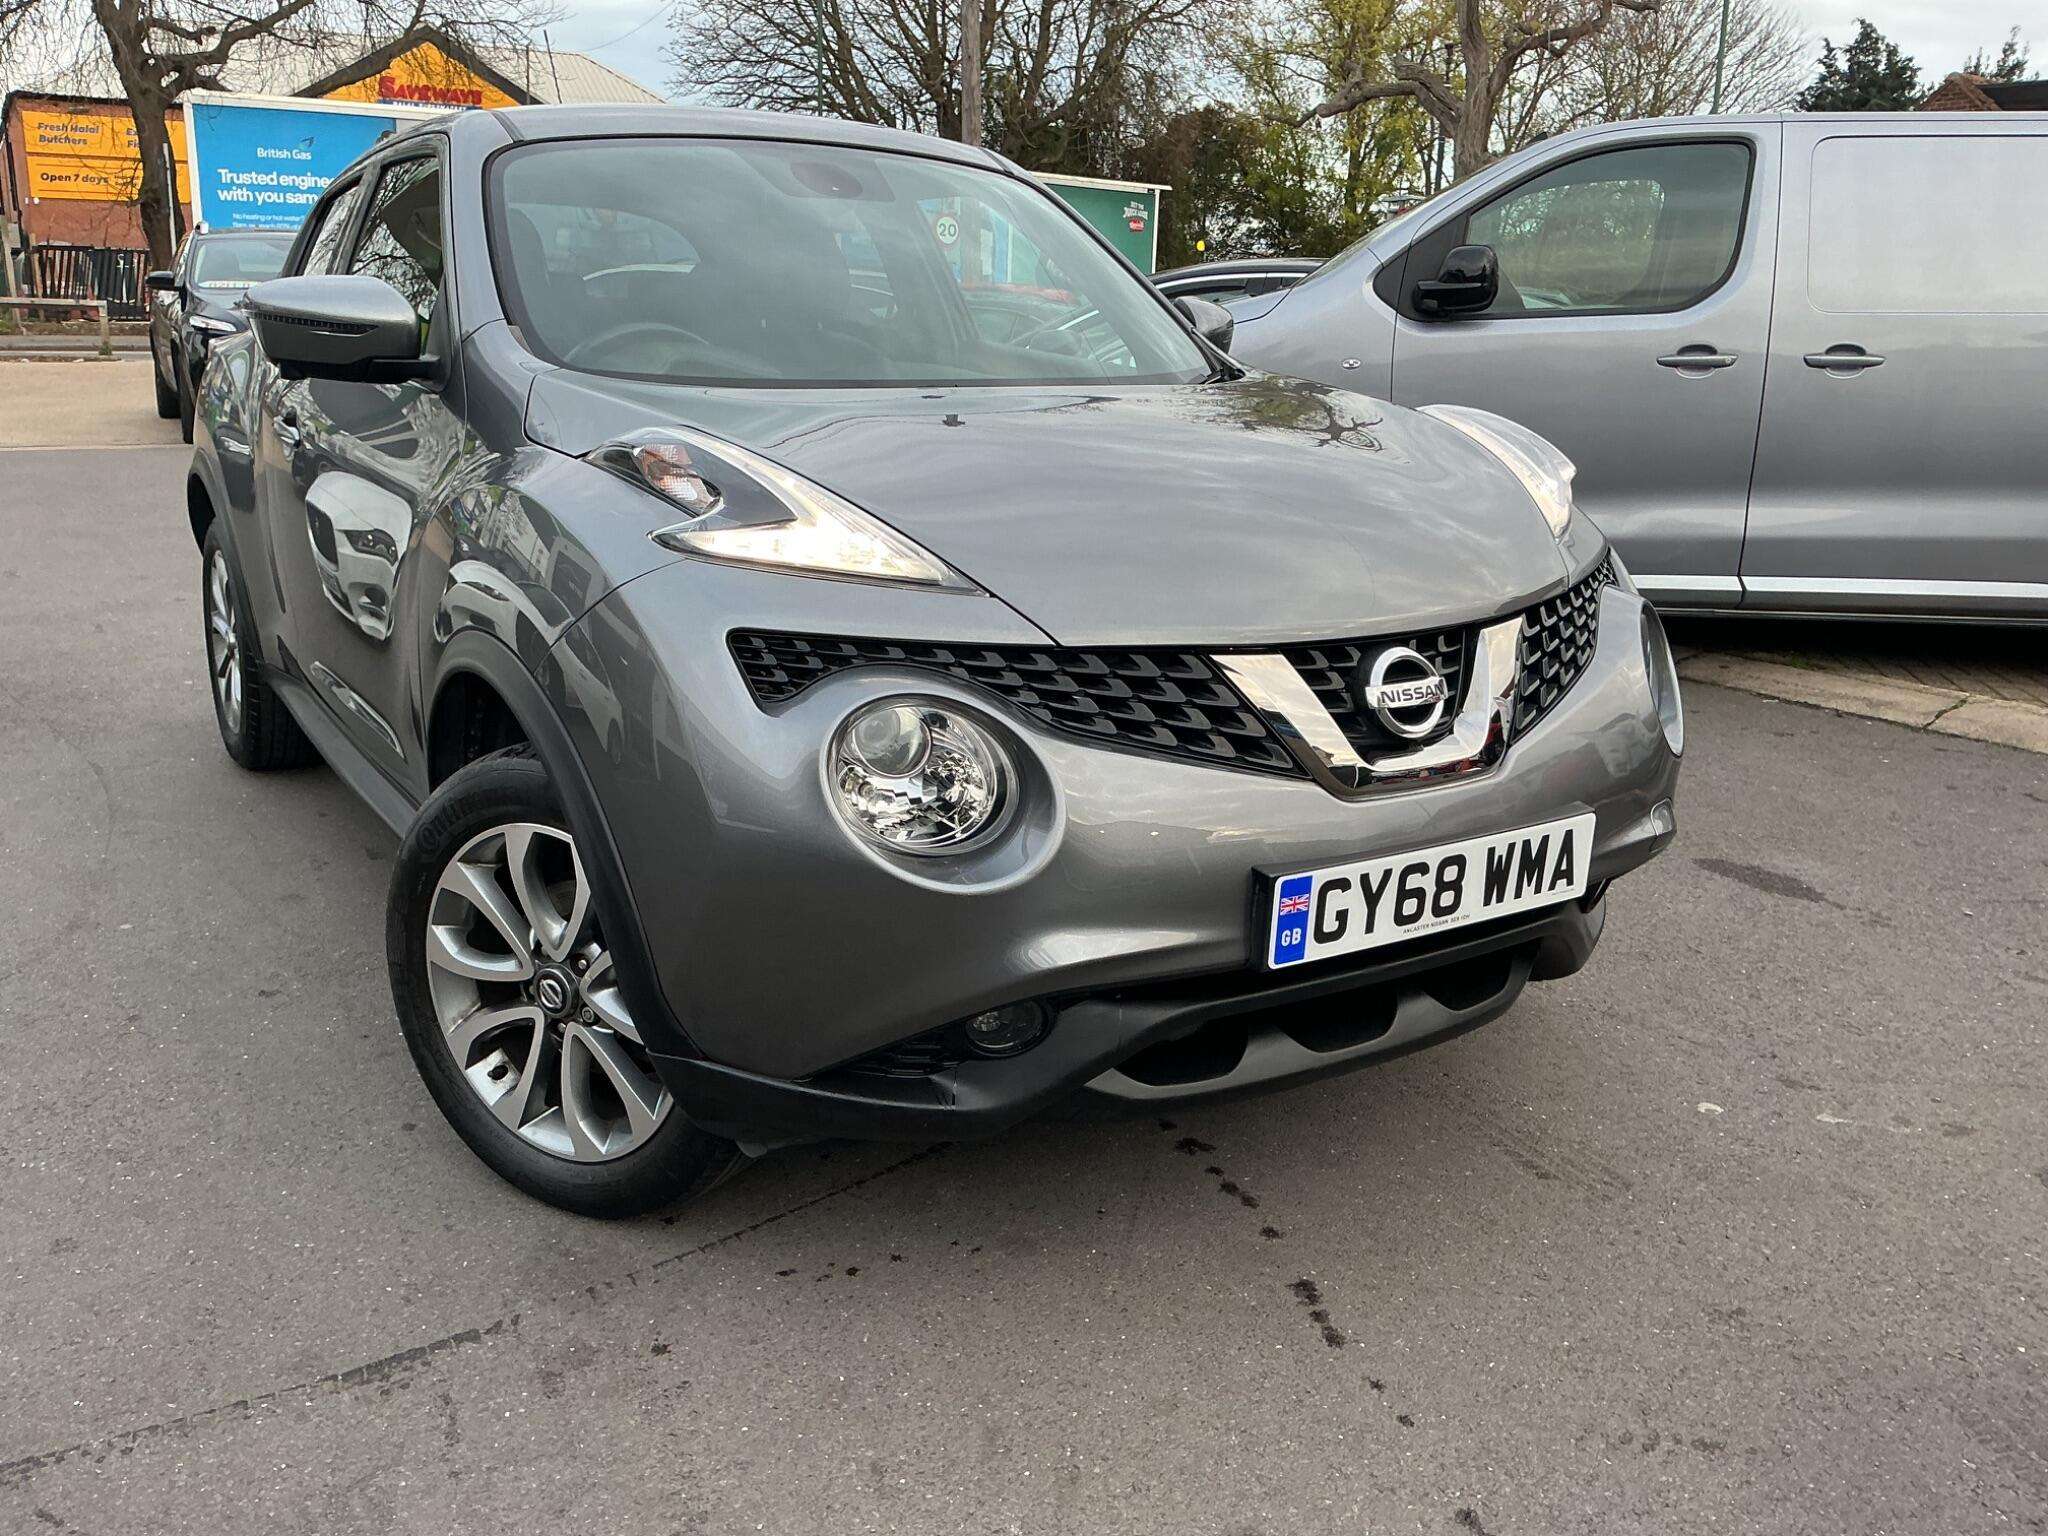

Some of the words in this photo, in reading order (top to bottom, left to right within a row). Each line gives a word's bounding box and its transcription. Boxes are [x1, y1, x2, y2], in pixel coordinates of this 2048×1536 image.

[37, 122, 68, 132] Fresh
[70, 124, 100, 134] Halal
[38, 135, 88, 145] Butchers
[256, 147, 291, 159] British
[292, 149, 312, 160] Gas
[40, 172, 72, 183] Open
[73, 174, 80, 182] 7
[82, 173, 109, 185] days
[217, 169, 278, 185] Trusted
[217, 186, 254, 201] with
[255, 190, 284, 206] you
[939, 222, 957, 238] 20
[1380, 679, 1445, 704] NISSAN
[1313, 854, 1467, 944] GY68
[1482, 828, 1575, 907] WMA
[1281, 927, 1302, 947] GB
